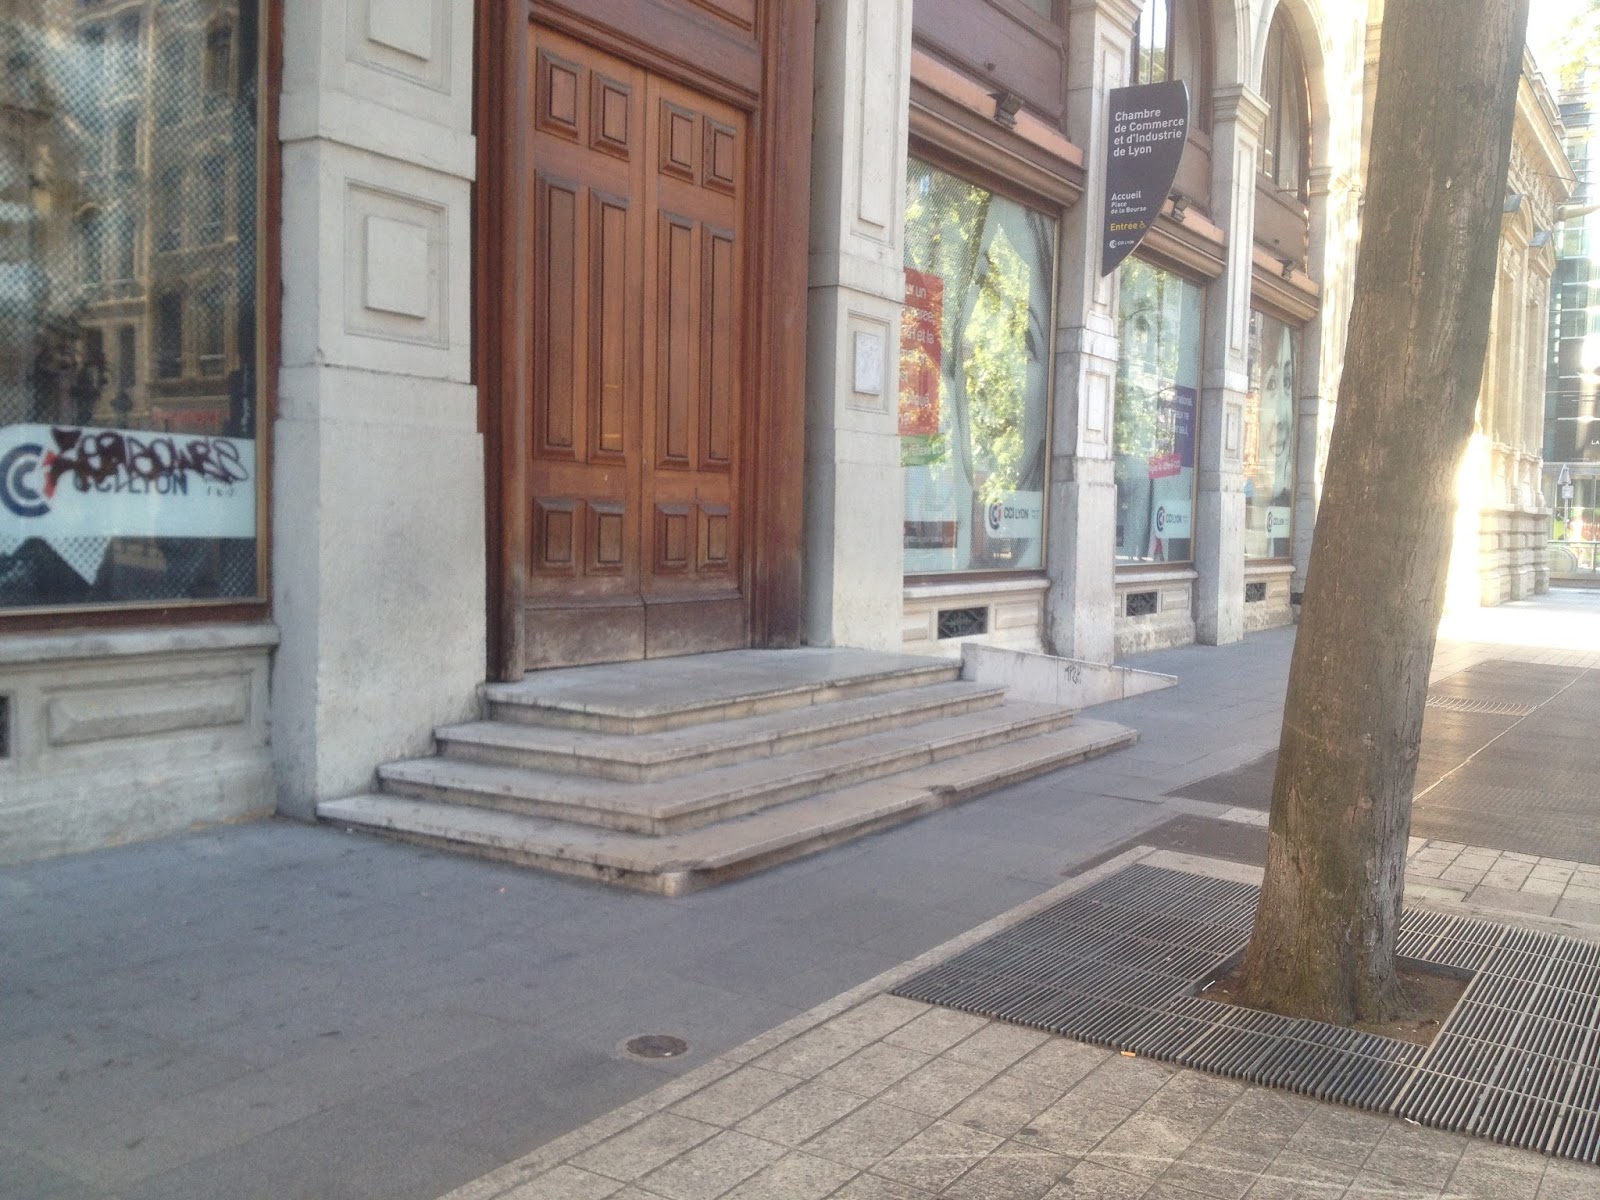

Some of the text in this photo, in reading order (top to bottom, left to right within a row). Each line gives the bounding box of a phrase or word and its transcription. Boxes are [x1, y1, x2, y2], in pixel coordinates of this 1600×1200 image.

[1115, 109, 1161, 121] Chambre
[1114, 118, 1184, 133] de Commerce
[1114, 129, 1182, 145] et d'Industrie
[1113, 145, 1152, 157] de Lyon
[1111, 190, 1142, 201] Accueil
[1015, 508, 1029, 520] LYON
